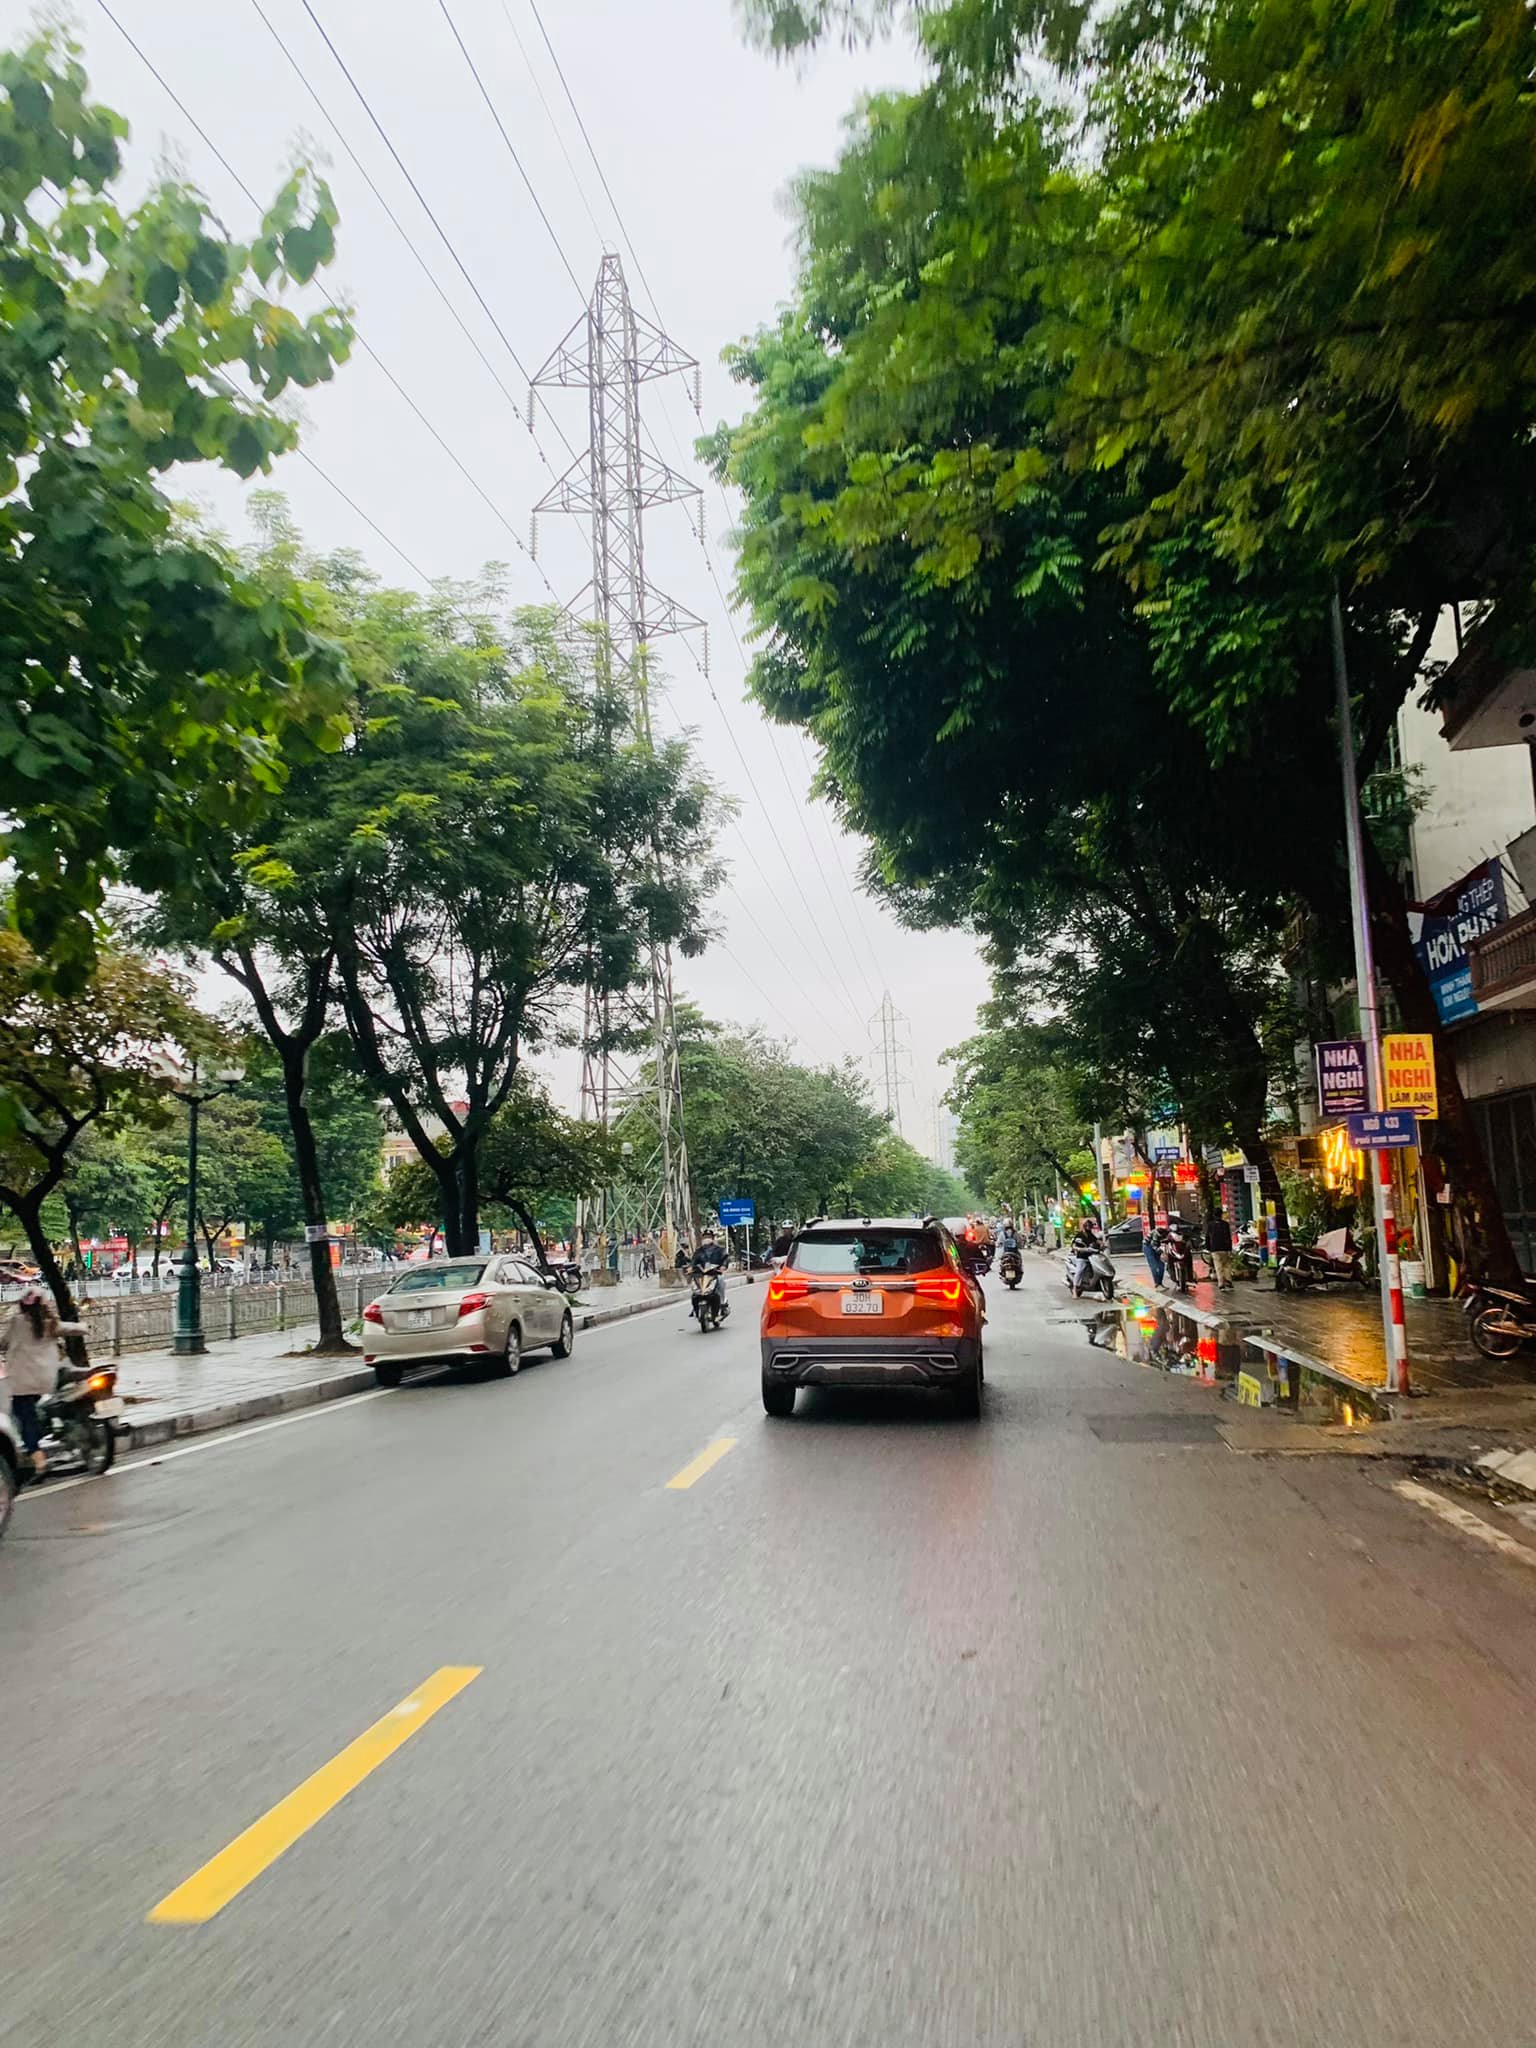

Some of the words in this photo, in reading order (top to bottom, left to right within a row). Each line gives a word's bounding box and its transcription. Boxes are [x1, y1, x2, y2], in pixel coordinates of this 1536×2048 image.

[1324, 1045, 1360, 1068] NHÀ
[1388, 1038, 1427, 1061] NHÀ
[1323, 1065, 1364, 1090] NGHỈ
[1388, 1062, 1432, 1089] NGHỈ
[1413, 1091, 1434, 1103] ANH
